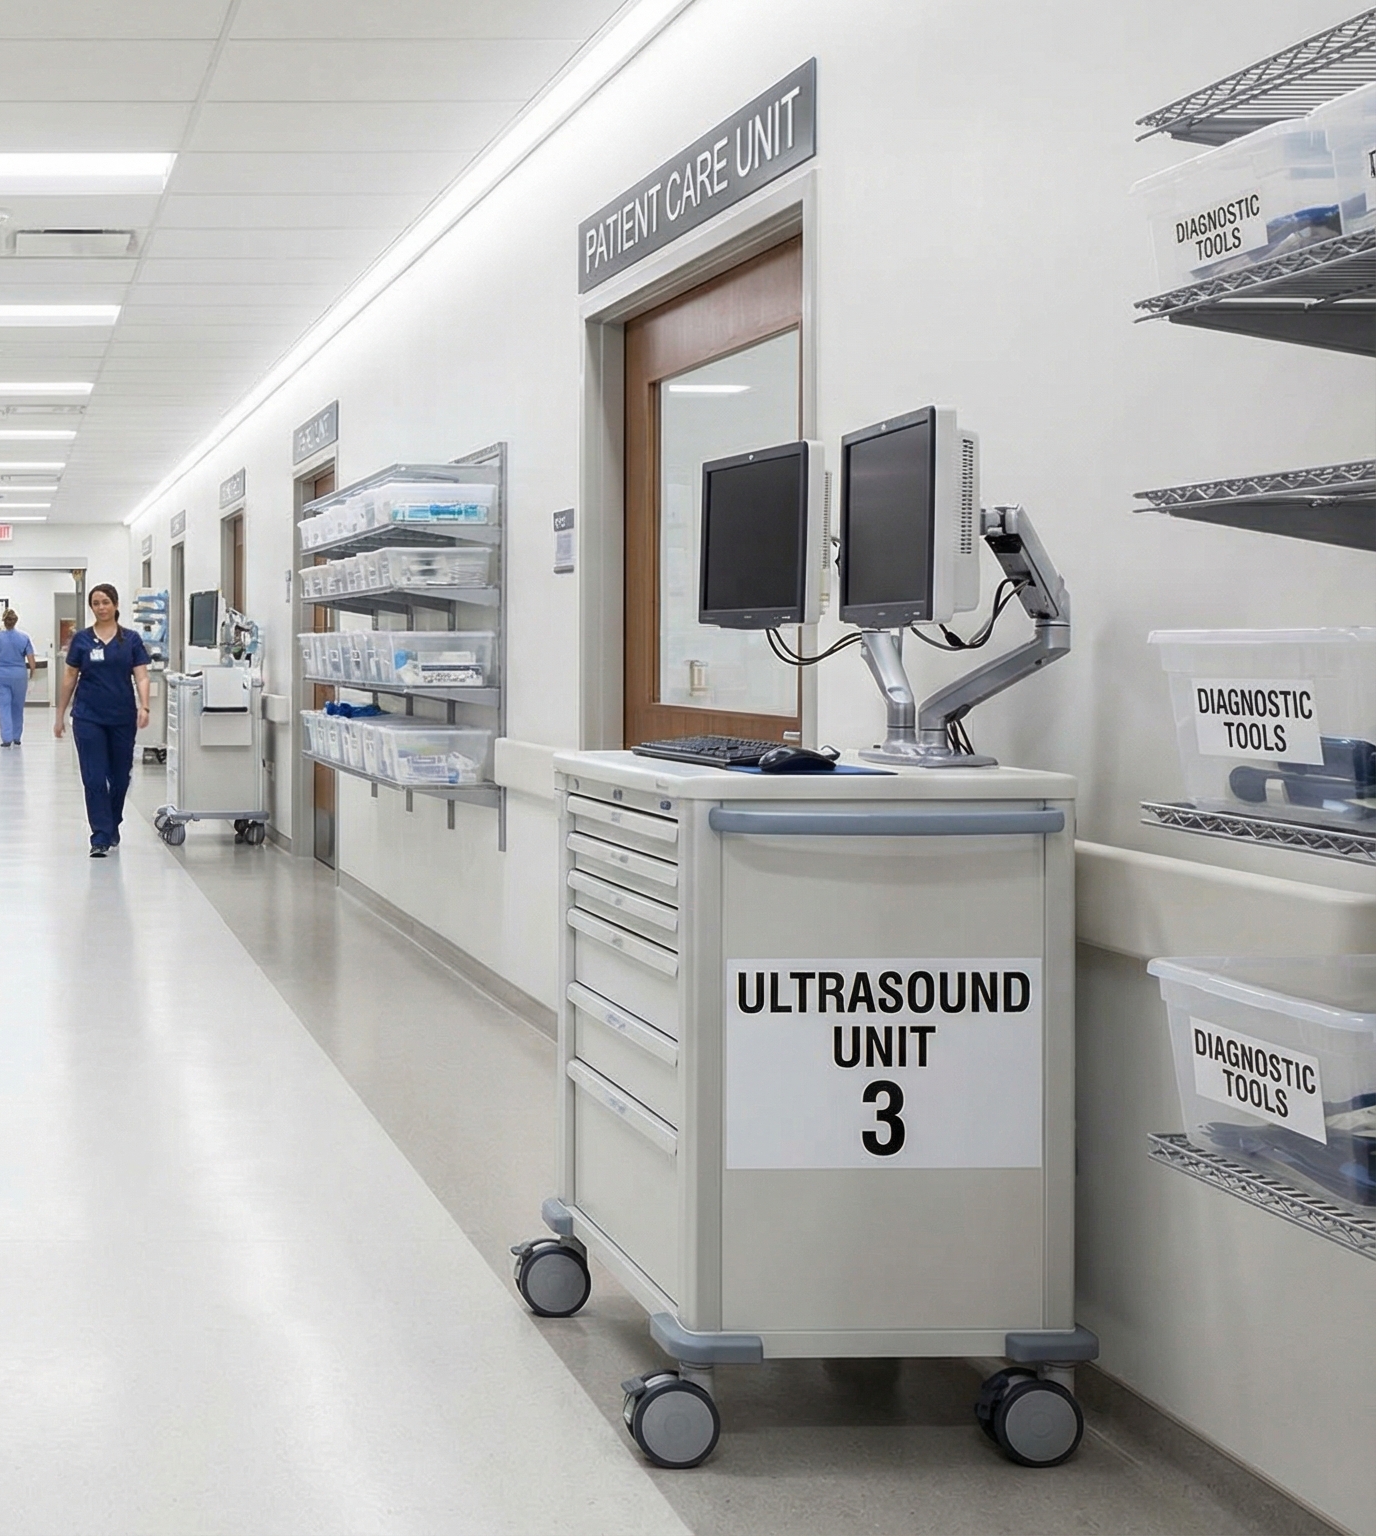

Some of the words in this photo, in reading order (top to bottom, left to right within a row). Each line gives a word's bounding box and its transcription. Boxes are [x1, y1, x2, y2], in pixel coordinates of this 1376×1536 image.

[586, 183, 661, 274] PATIENT
[665, 136, 728, 222] CARE
[736, 85, 801, 178] UNIT
[1175, 194, 1260, 244] DIAGNOSTIC
[1195, 226, 1242, 261] TOOLS
[1197, 687, 1313, 720] DIAGNOSTIC
[1223, 721, 1287, 753] TOOLS
[738, 970, 1031, 1014] ULTRASOUND
[833, 1025, 936, 1069] UNIT
[1194, 1028, 1316, 1095] DIAGNOSTIC
[1222, 1068, 1289, 1118] TOOLS
[861, 1079, 906, 1157] 3
